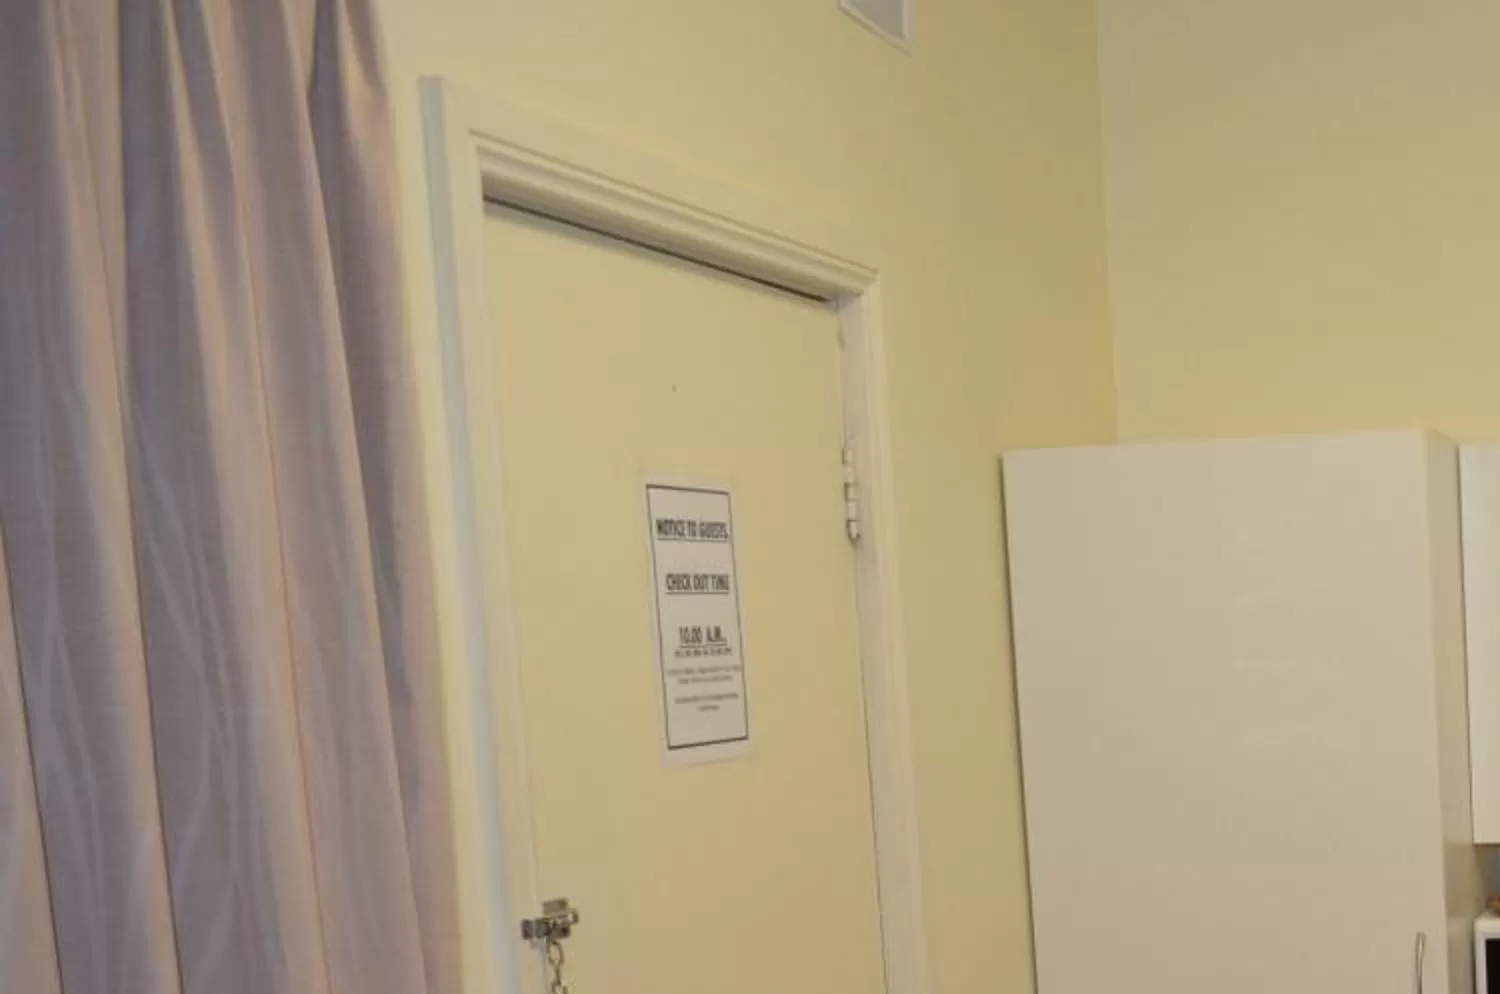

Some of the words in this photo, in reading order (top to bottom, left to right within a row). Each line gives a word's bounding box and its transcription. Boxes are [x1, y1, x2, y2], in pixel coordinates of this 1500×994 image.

[656, 518, 685, 537] NOTICE
[687, 520, 697, 537] TO
[666, 573, 692, 591] CHECK
[693, 574, 709, 591] OUT
[711, 574, 729, 591] TIME
